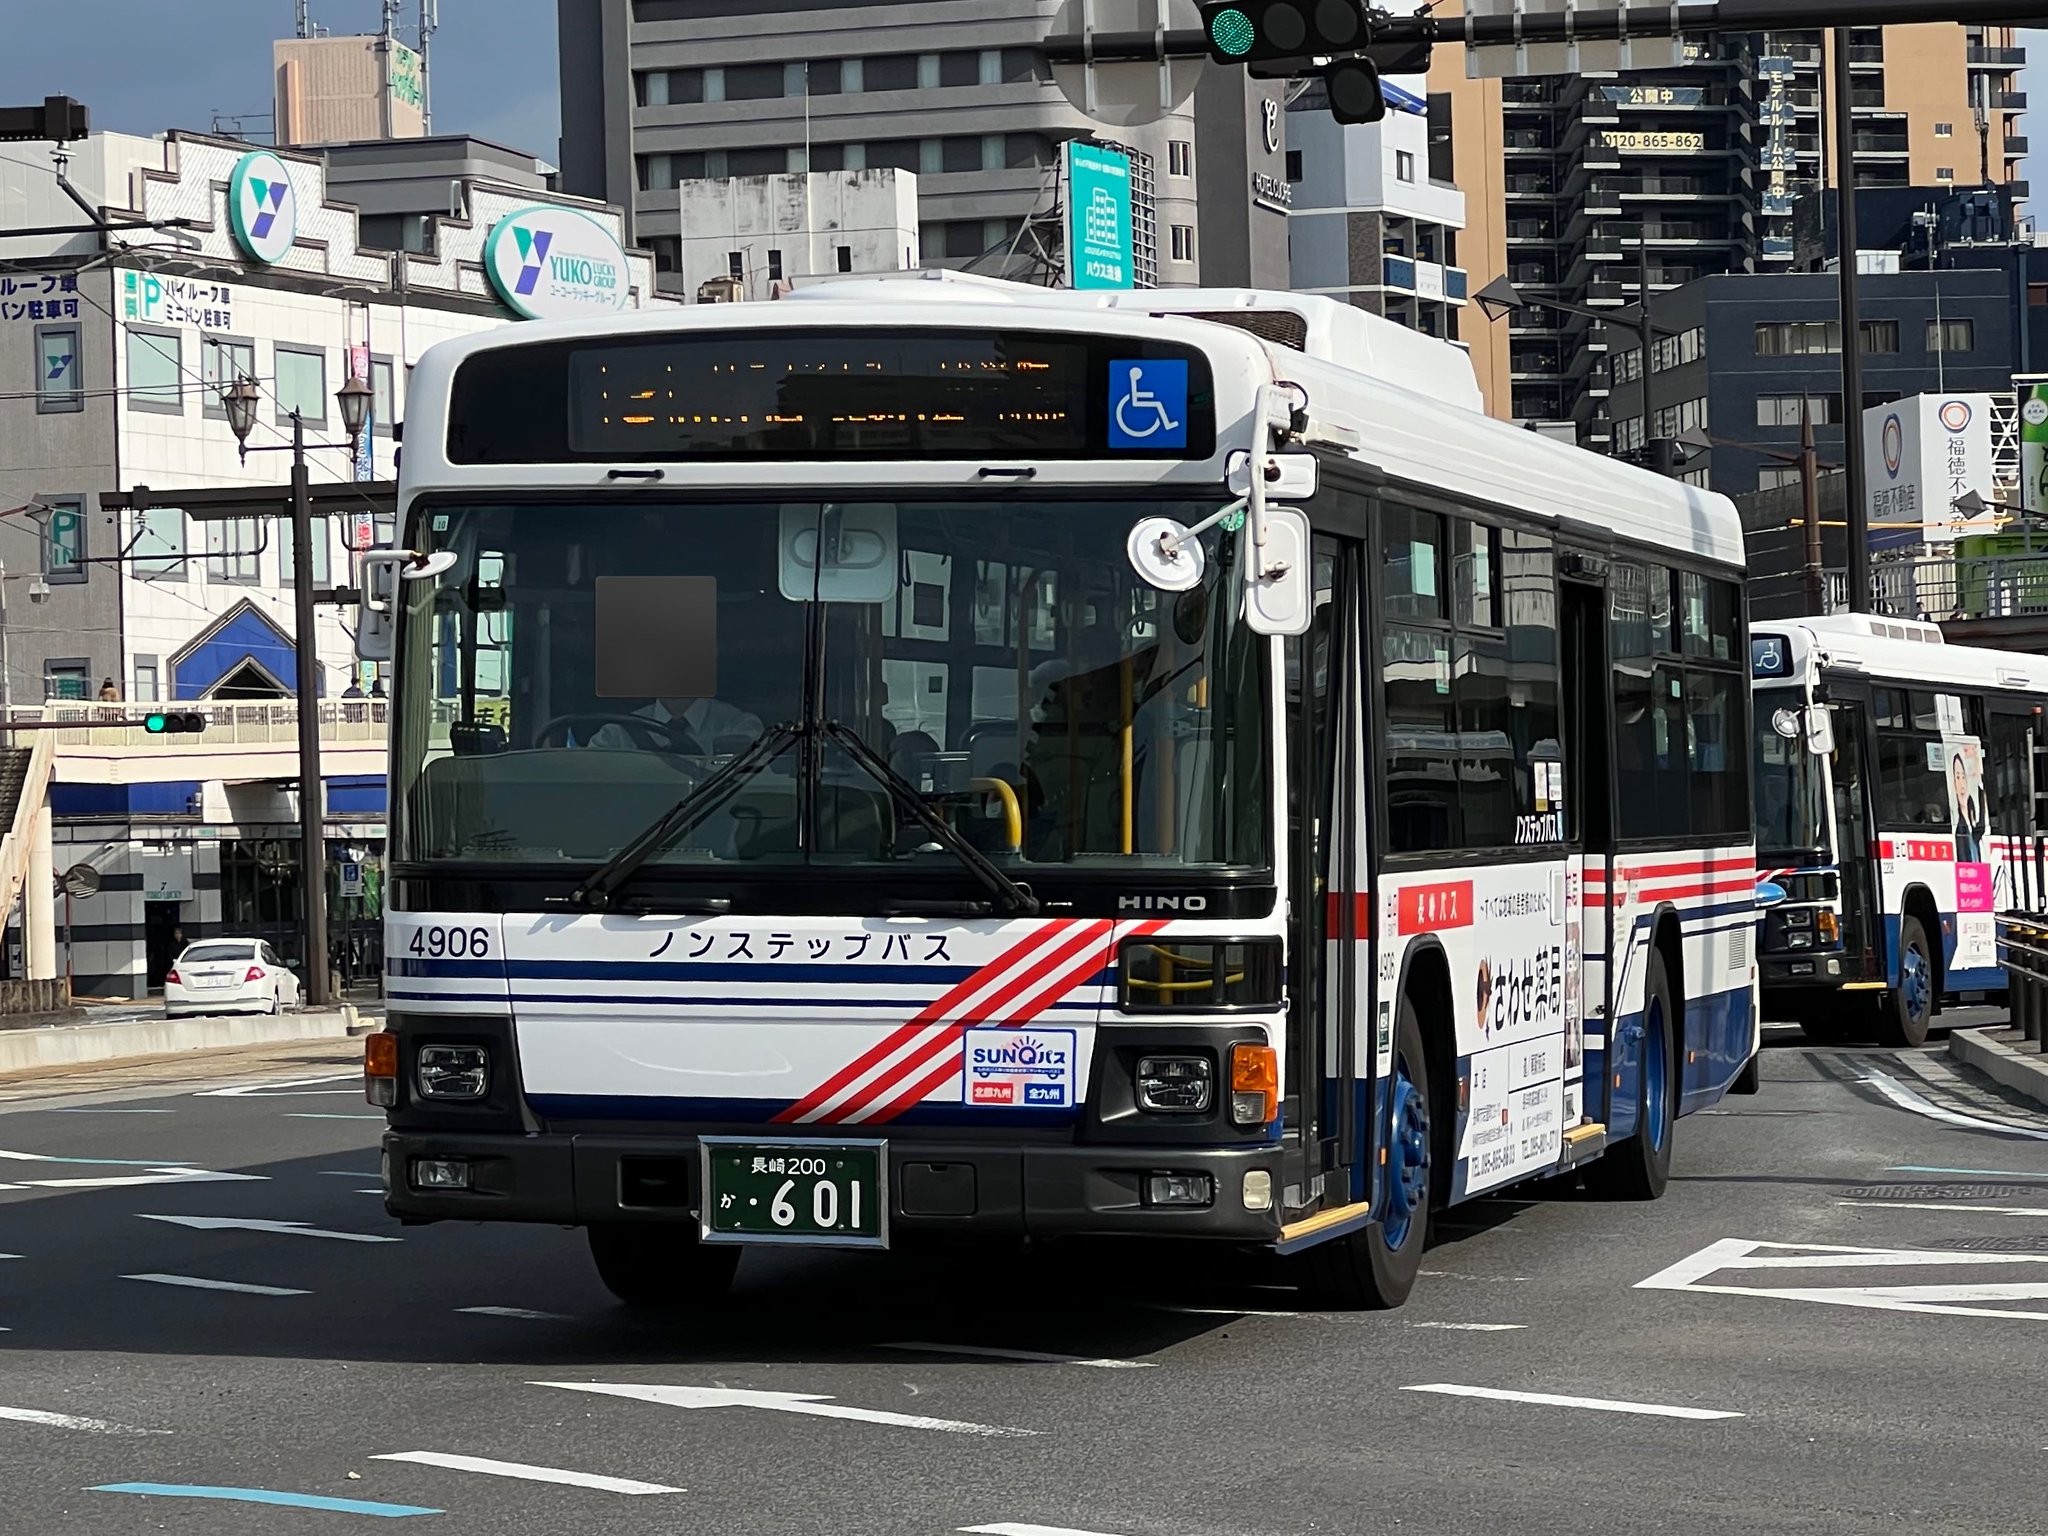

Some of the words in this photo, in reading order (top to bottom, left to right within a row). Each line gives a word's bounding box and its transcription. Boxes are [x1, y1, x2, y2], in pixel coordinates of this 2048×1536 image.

[1603, 134, 1701, 148] 0120-865-862
[1769, 71, 1786, 199] モデルルーム公開中
[550, 255, 592, 285] YUKO
[592, 262, 616, 276] LUCKY
[593, 275, 616, 289] GROUP
[143, 278, 161, 317] P
[165, 279, 231, 305] ハイルーフ車
[165, 303, 231, 331] ミニバン駐車可
[53, 510, 76, 545] P
[1514, 814, 1558, 845] ノンステップバス
[1118, 895, 1207, 911] HINO
[1417, 891, 1458, 924] 長崎バス
[408, 926, 490, 959] 4906
[647, 930, 954, 963] ノンステップバス
[1494, 945, 1561, 1031] さわせ薬局
[973, 1046, 1066, 1065] SUNQパス
[974, 1086, 1012, 1099] 北部九州
[1029, 1087, 1060, 1100] 全九州
